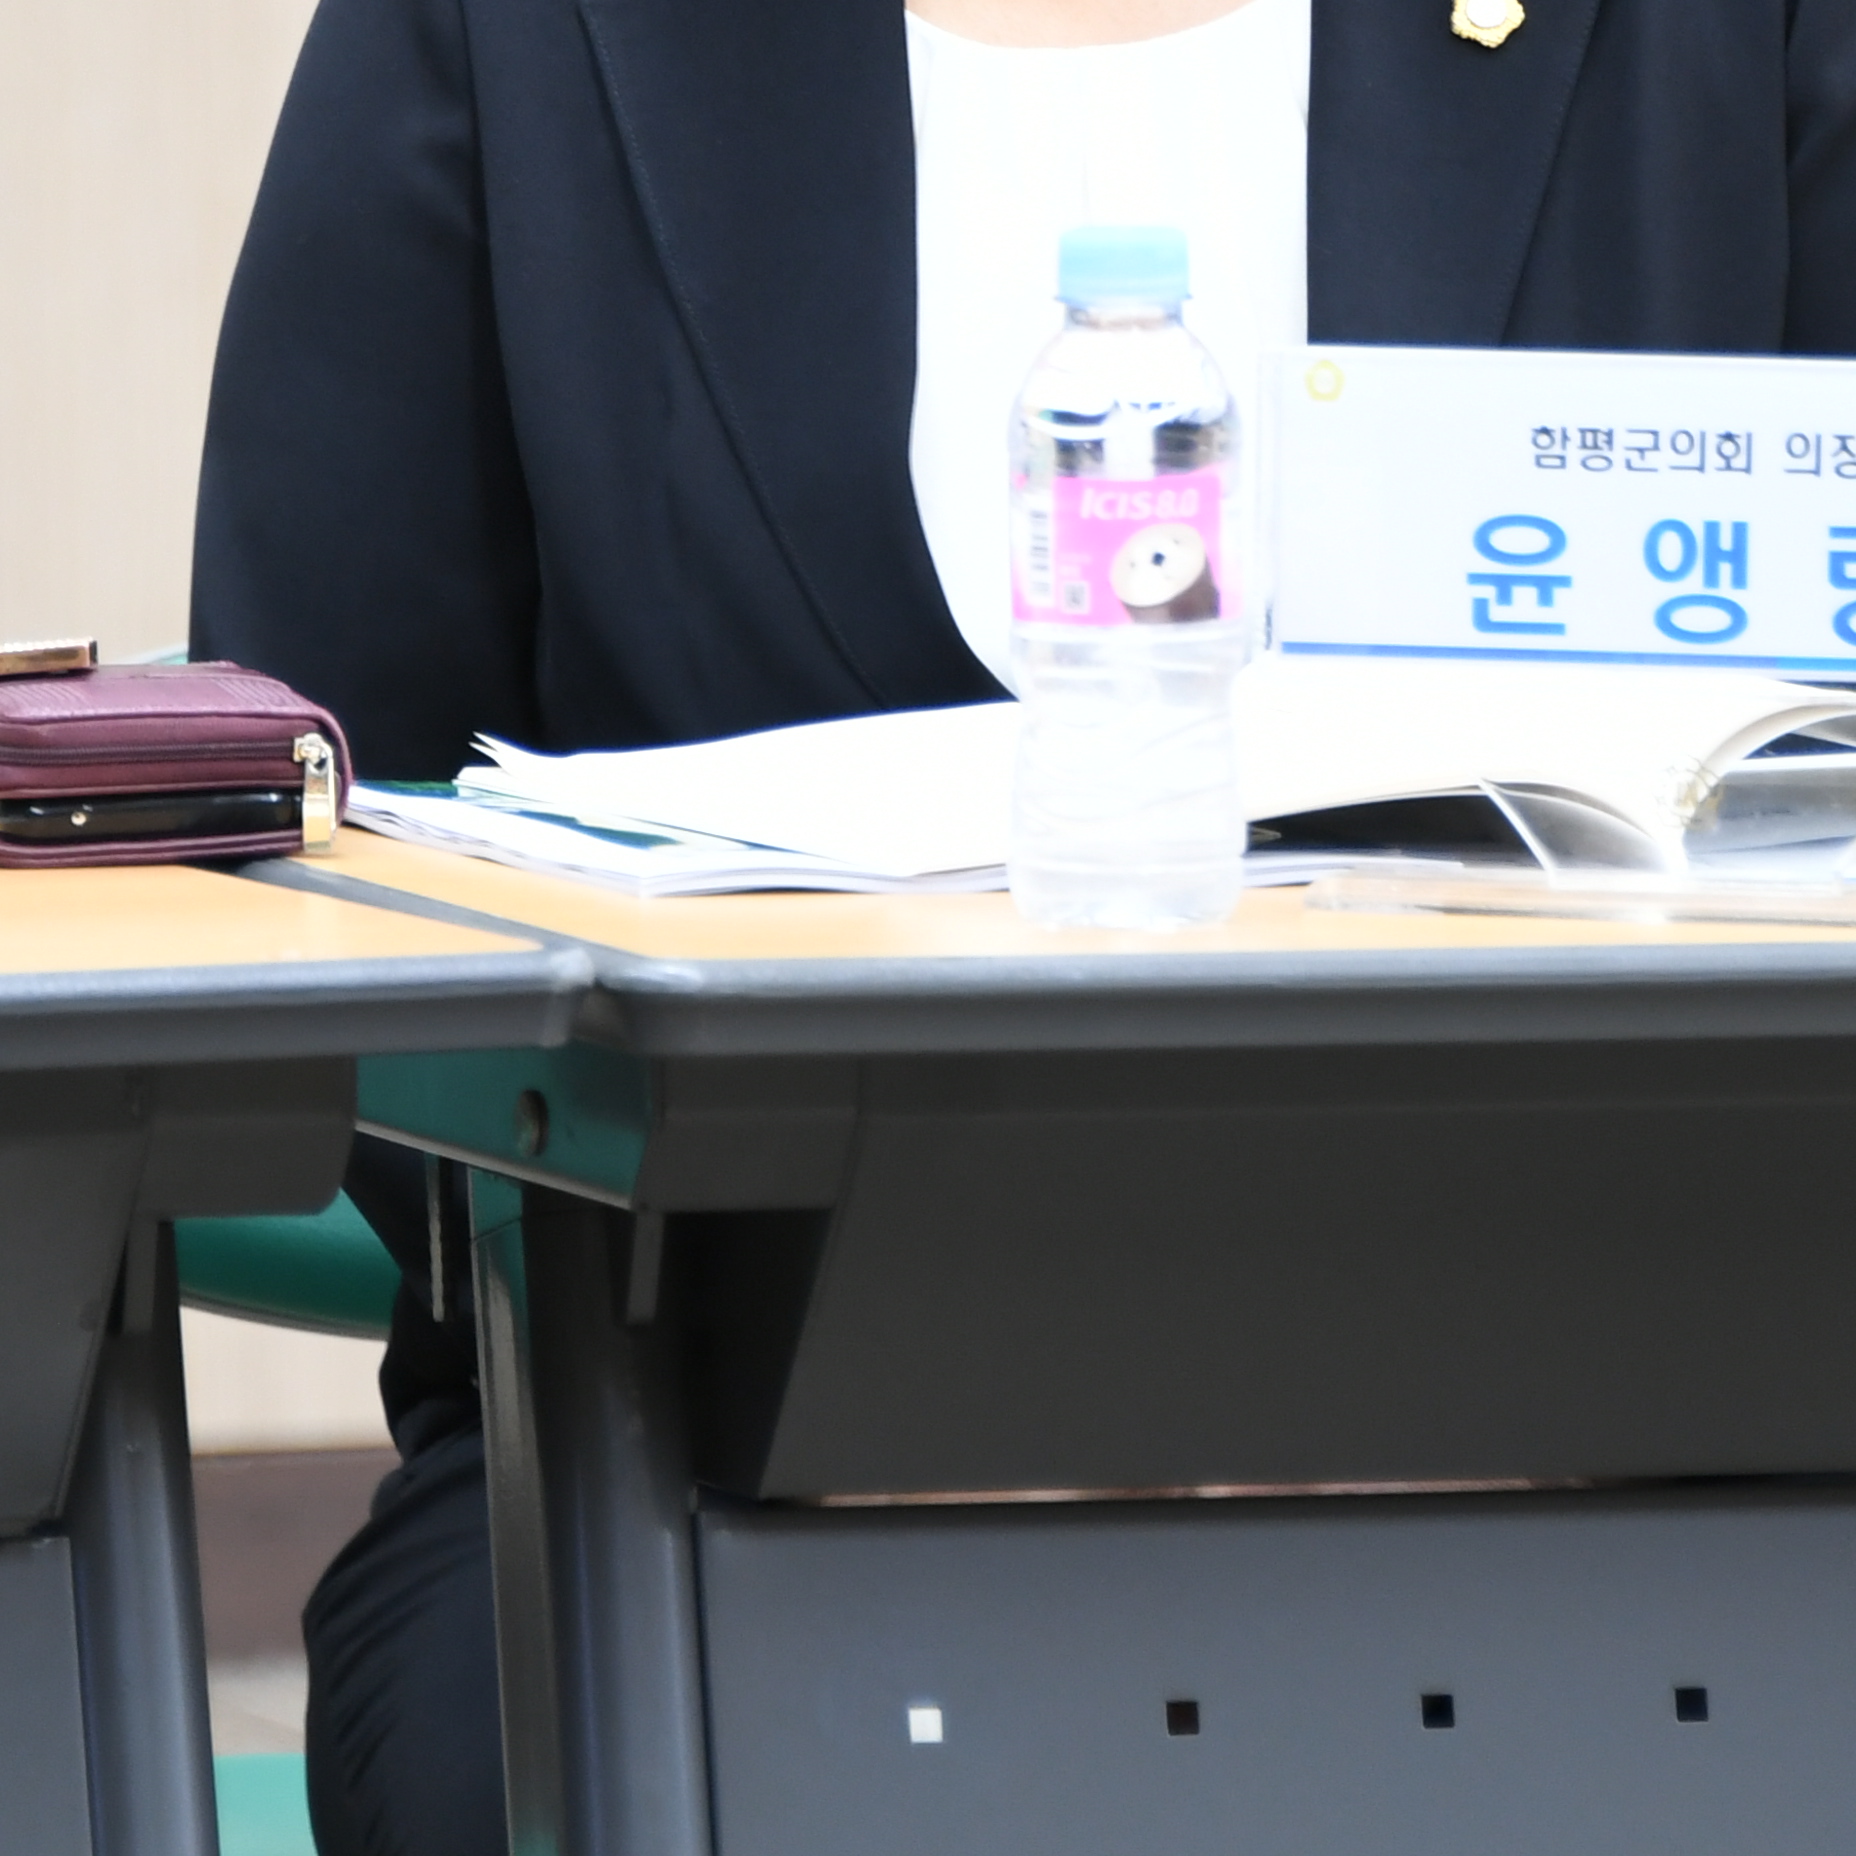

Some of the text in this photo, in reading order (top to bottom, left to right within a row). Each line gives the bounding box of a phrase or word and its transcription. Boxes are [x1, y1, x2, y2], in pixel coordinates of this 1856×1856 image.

[1531, 425, 1753, 475] 함평군의회
[1466, 513, 1573, 636] 윤
[1643, 518, 1749, 645] 앵
